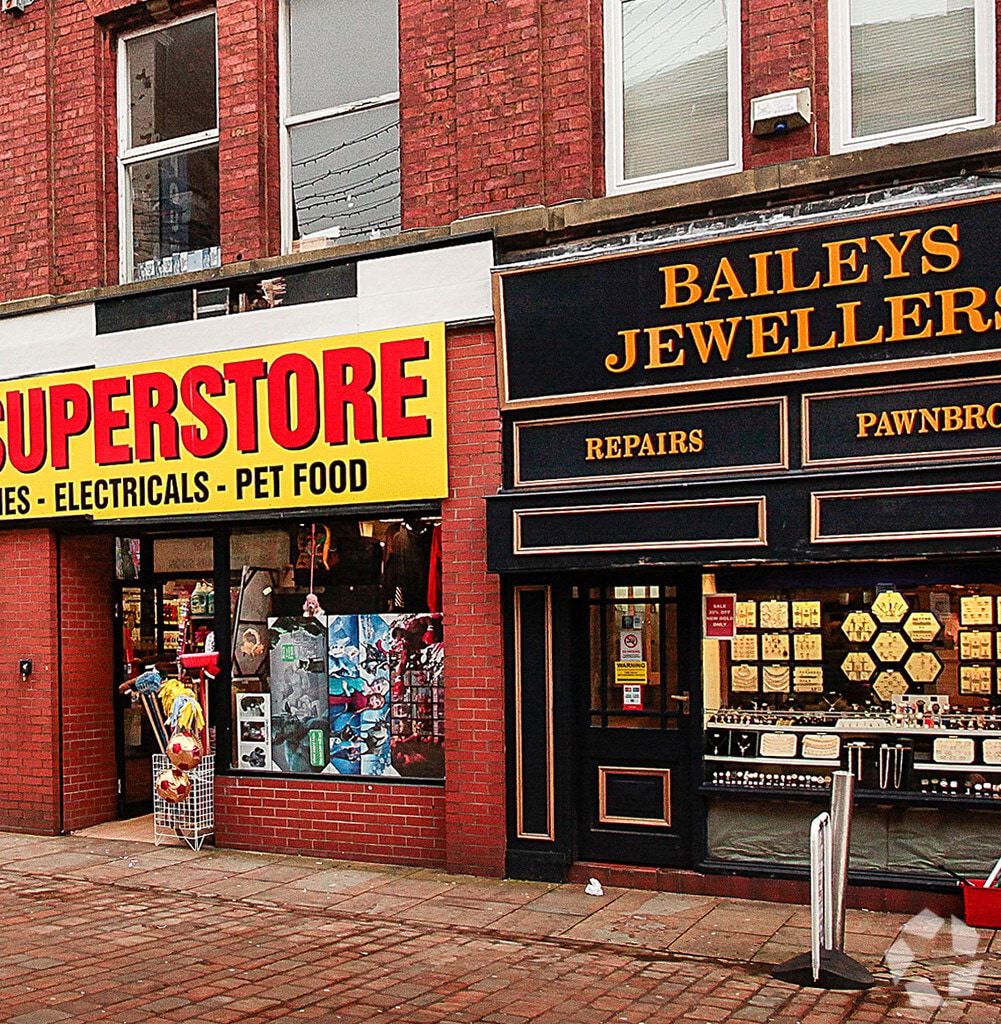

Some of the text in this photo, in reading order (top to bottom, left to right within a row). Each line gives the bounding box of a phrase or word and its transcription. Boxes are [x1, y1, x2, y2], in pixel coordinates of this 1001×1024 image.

[658, 222, 962, 310] BAILEYS
[603, 285, 1001, 374] JEWELLER
[584, 427, 704, 461] REPAIRS
[54, 470, 210, 513] ELECTRICALS
[235, 464, 285, 501] PET
[293, 457, 368, 497] FOOD
